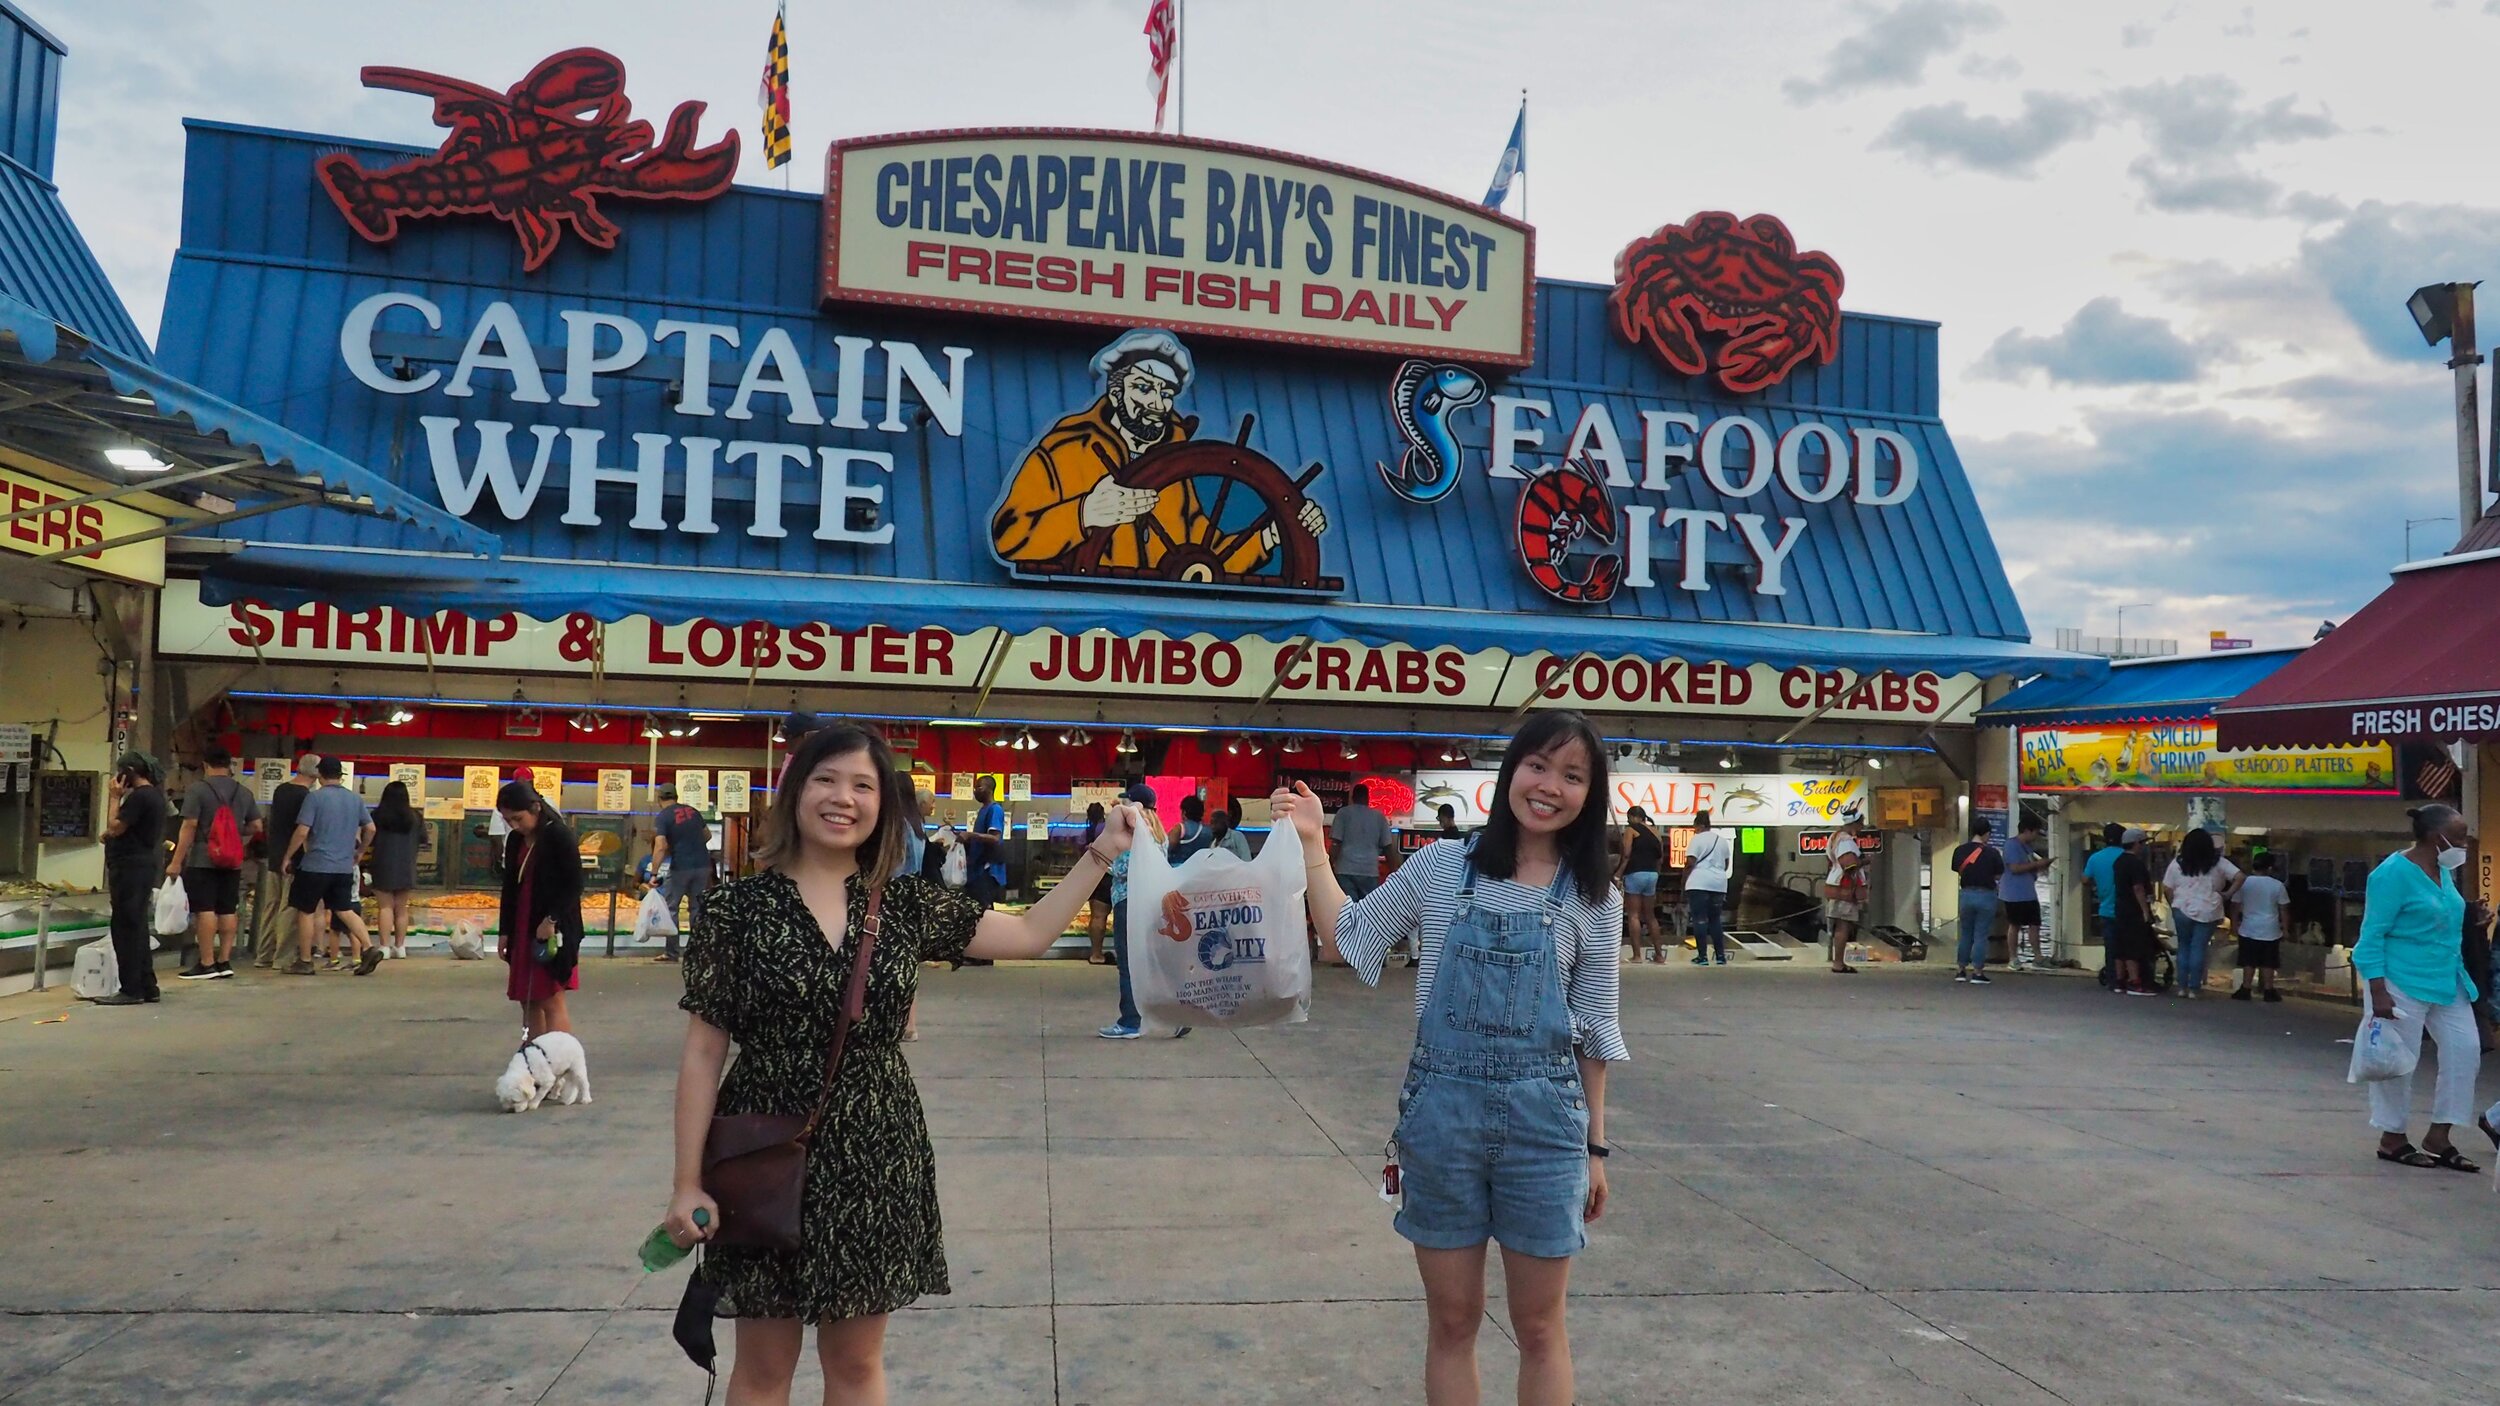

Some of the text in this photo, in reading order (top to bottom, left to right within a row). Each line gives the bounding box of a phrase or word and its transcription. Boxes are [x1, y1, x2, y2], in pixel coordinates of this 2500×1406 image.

[876, 153, 1497, 292] CHESAPEAKE BAY'S FINEST
[906, 240, 1469, 332] FRESH FISH DAILY
[340, 292, 974, 437] CAPTAIN
[419, 415, 895, 545] WHITE
[228, 598, 954, 675] SHRIMP & LOBSTER
[1029, 635, 1467, 697] JUMBO CRABS
[1535, 655, 1940, 714] COOKED CRABS
[2151, 724, 2202, 749] SPICED
[2351, 708, 2421, 736] FRESH
[2025, 729, 2060, 762] RAW
[2037, 747, 2066, 778] BAR
[2150, 750, 2206, 775] SHRIMP
[2233, 756, 2354, 775] SEAFOOD PLATTERS
[1614, 781, 1716, 815] SALE
[1802, 779, 1850, 796] Bushel
[1787, 800, 1824, 817] Blow
[1184, 981, 1197, 990] ON
[1199, 978, 1213, 988] THE
